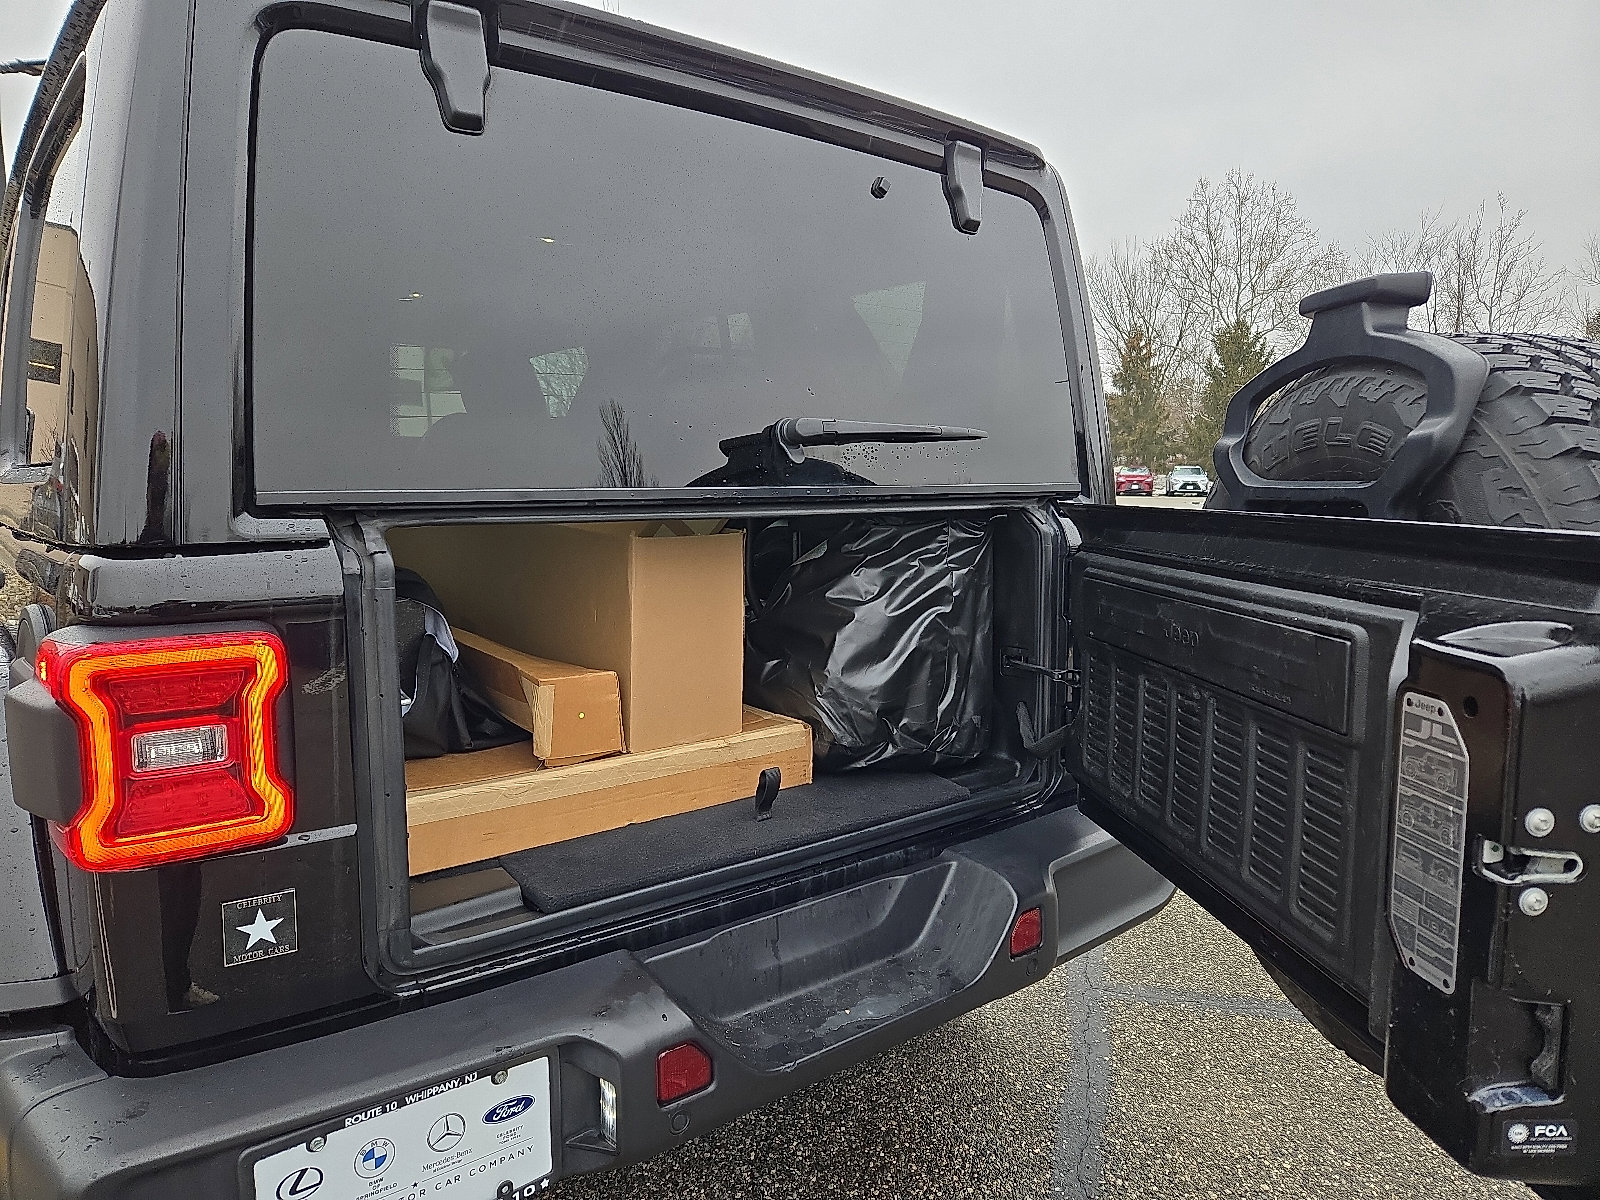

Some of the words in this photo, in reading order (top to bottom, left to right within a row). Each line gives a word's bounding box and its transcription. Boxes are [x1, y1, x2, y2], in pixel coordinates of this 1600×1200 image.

[1415, 700, 1436, 714] Jeep
[236, 894, 283, 909] CELEBRITY
[232, 949, 265, 963] MOTOR
[268, 944, 290, 955] CARS
[344, 1105, 383, 1128] ROUTE
[385, 1101, 398, 1112] 10
[404, 1077, 462, 1105] WHIPPANY,
[465, 1071, 478, 1083] NJ
[492, 1099, 526, 1121] Ford
[1534, 1124, 1568, 1137] FCA
[360, 1140, 390, 1157] BMW
[421, 1147, 473, 1172] Mercedes-Benz
[434, 1174, 461, 1191] CAR
[469, 1144, 534, 1177] COMPANY
[511, 1184, 536, 1200] 10
